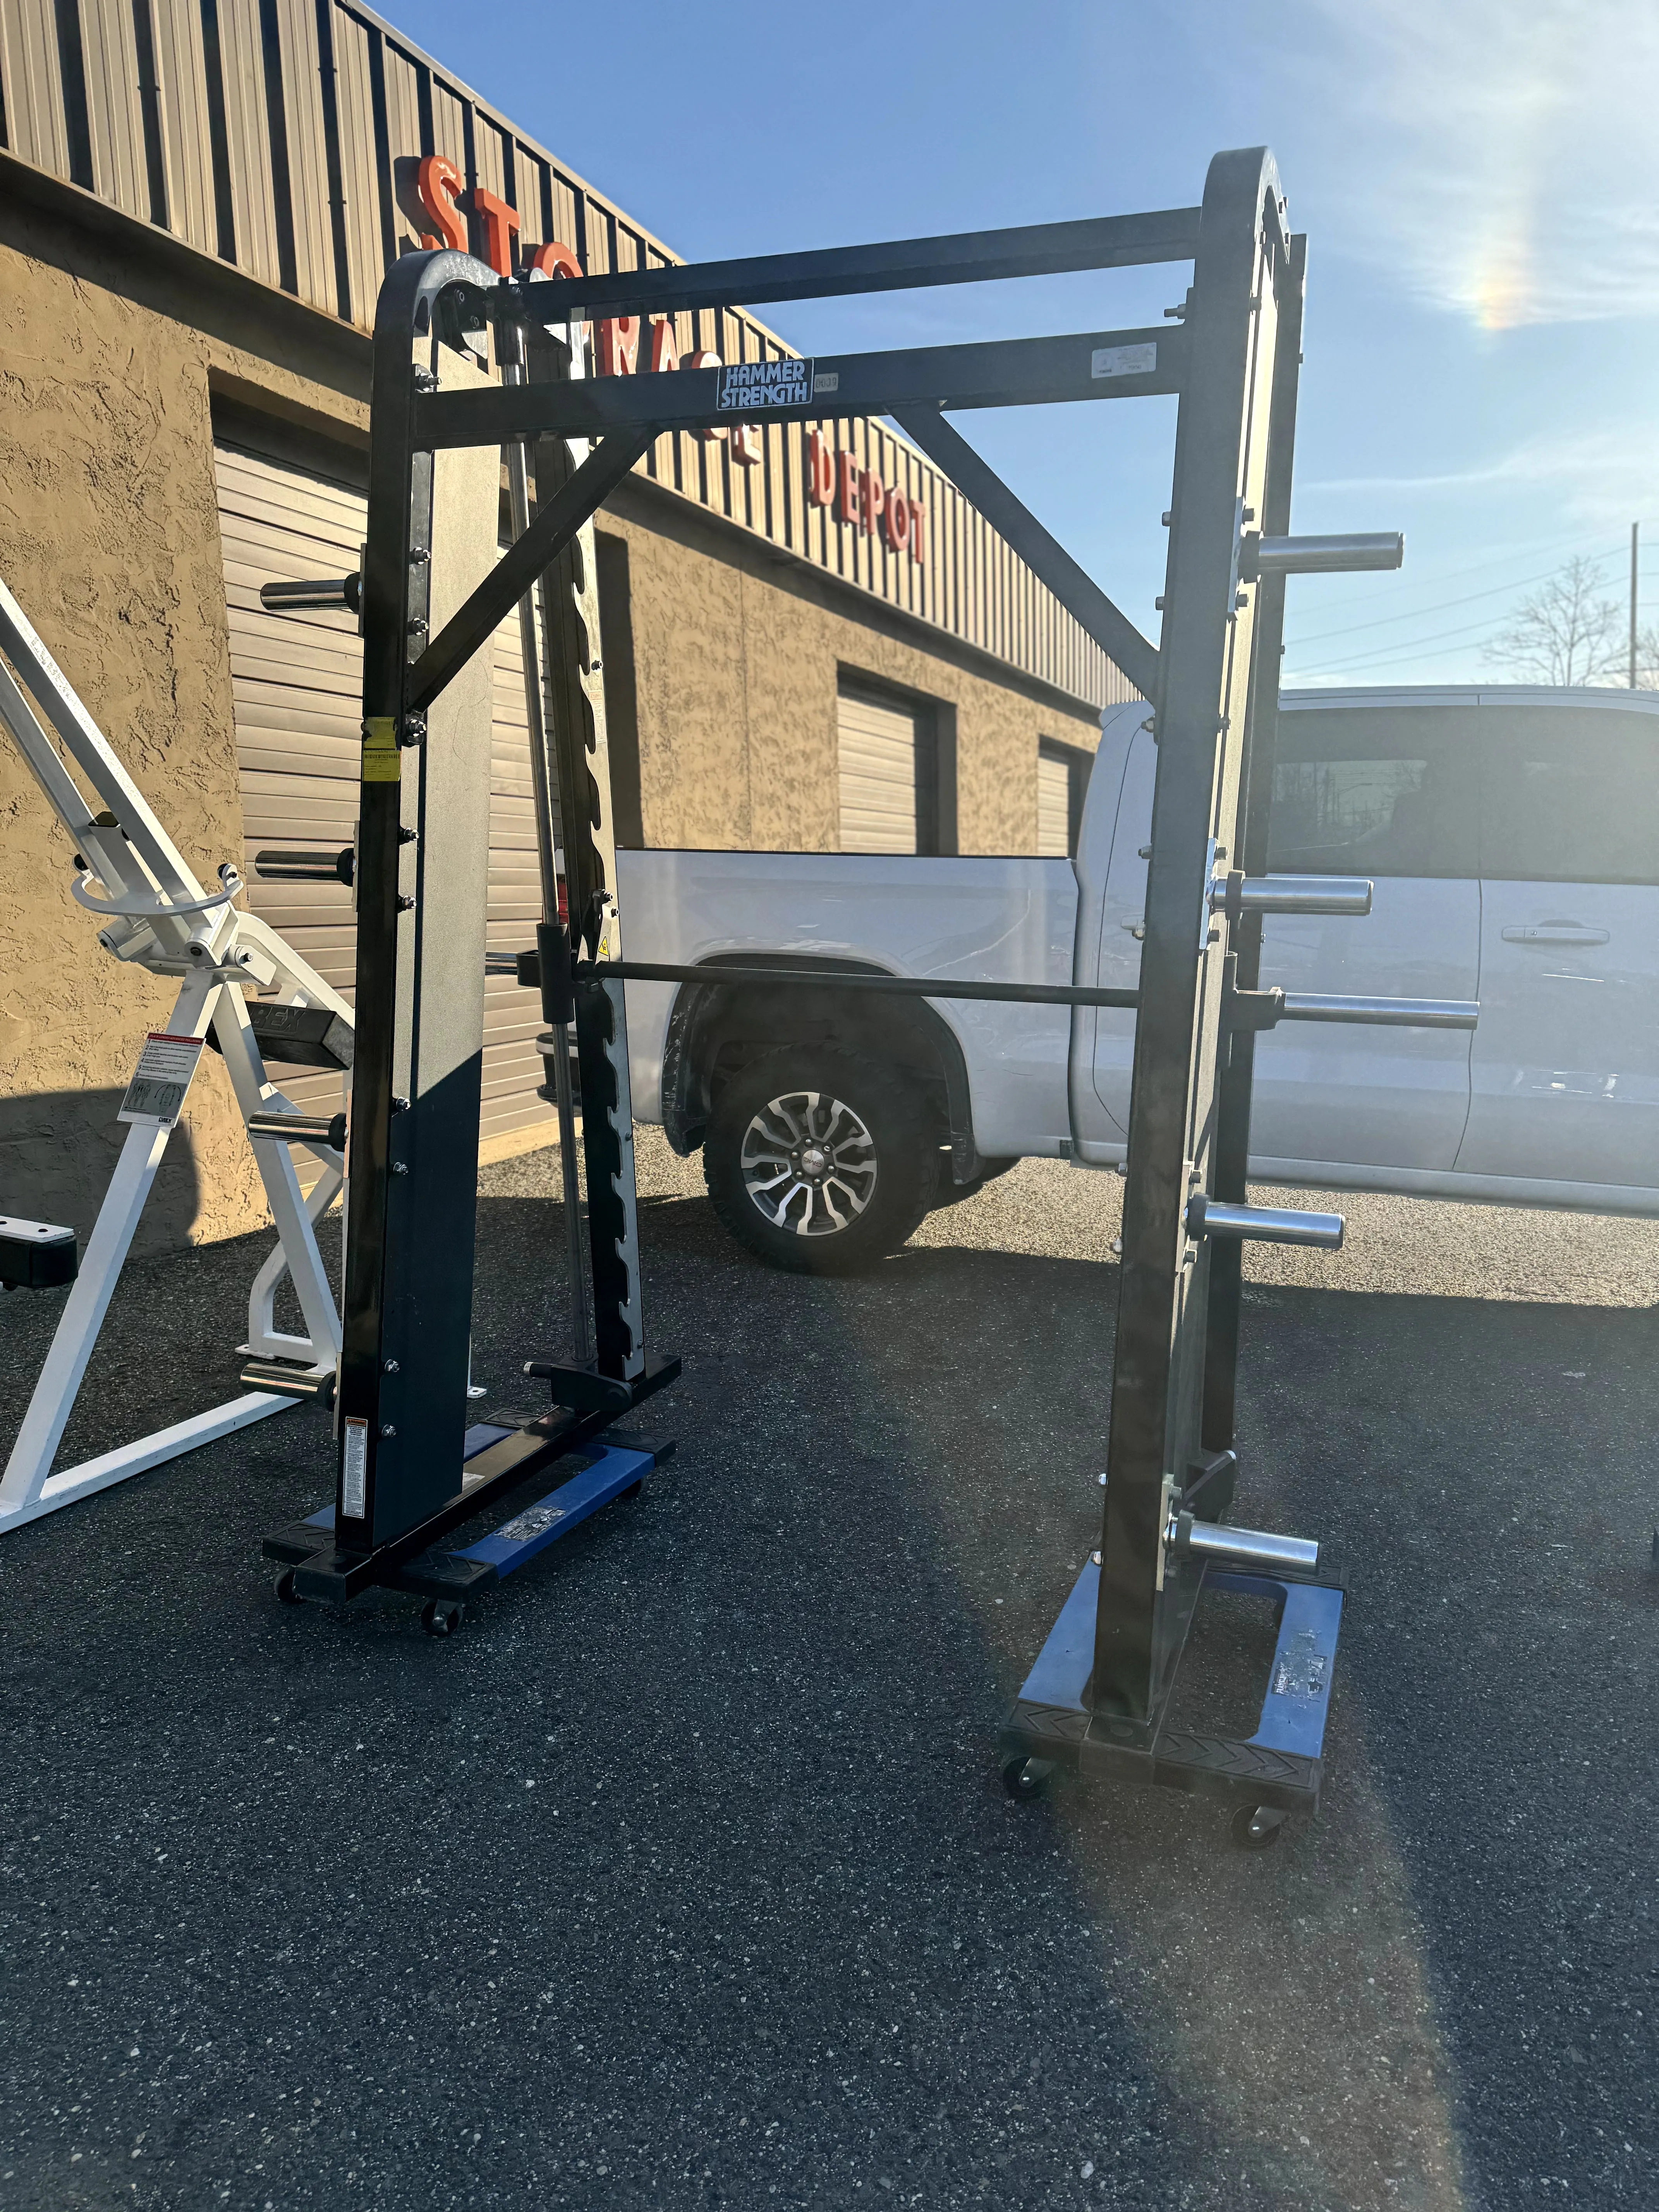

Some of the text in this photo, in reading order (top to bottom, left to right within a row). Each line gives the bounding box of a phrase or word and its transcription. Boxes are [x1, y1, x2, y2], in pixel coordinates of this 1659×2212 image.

[726, 361, 805, 389] HAMMER
[721, 381, 807, 408] STRENGTH
[809, 429, 926, 564] DEPOT
[804, 1157, 822, 1167] GMC
